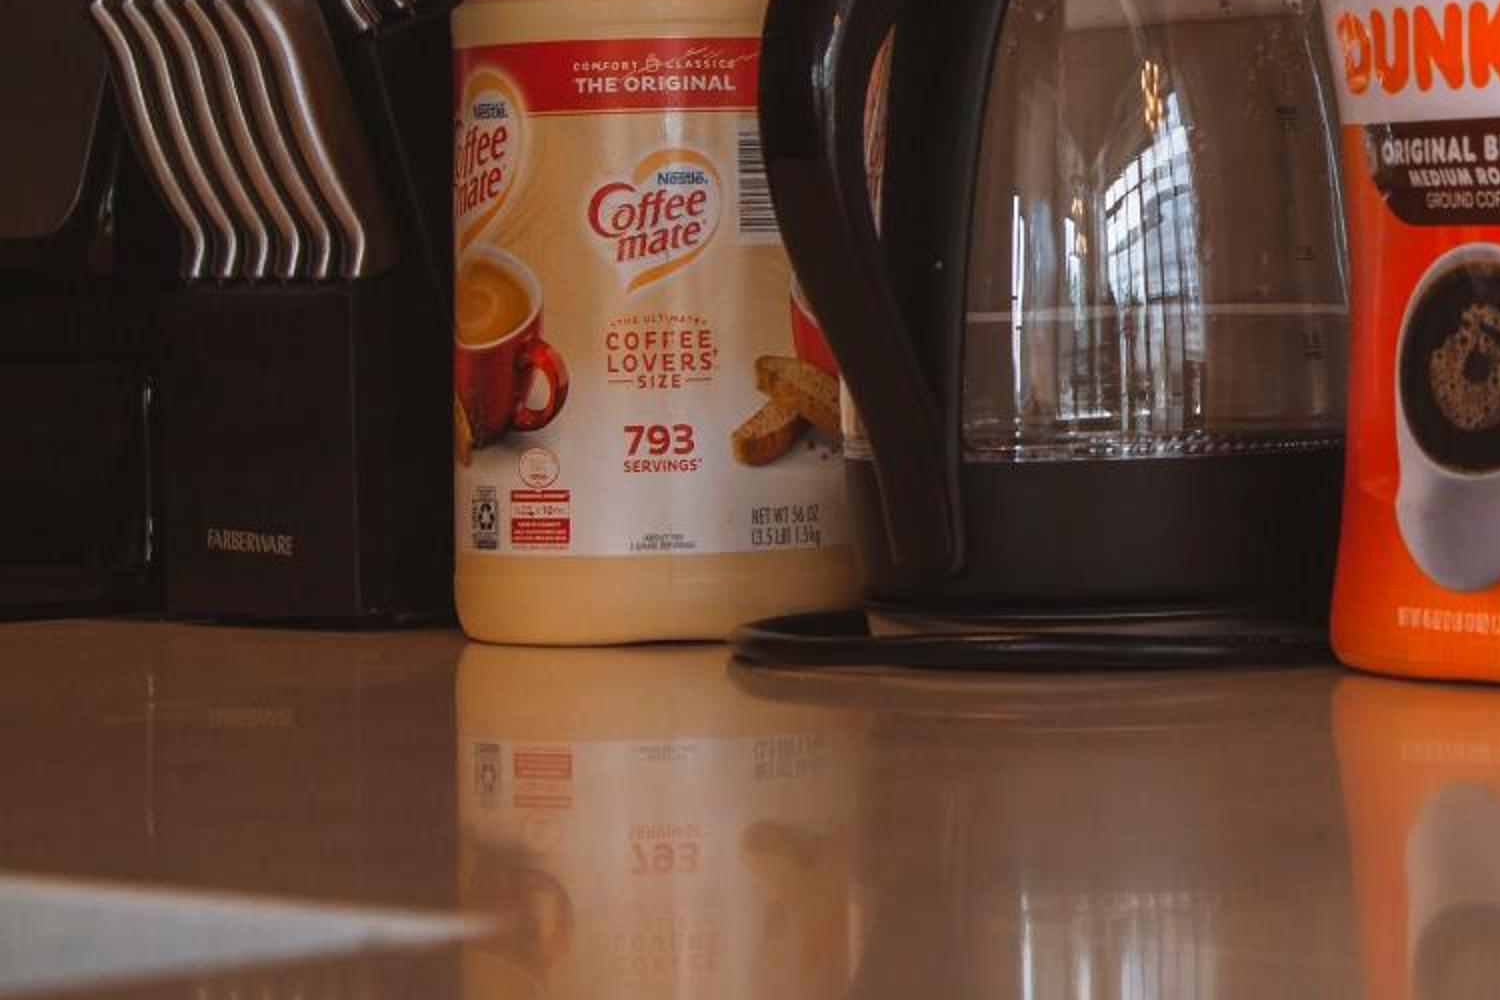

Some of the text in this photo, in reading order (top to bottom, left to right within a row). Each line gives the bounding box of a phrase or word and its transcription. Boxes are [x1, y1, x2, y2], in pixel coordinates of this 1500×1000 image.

[573, 59, 637, 72] COMFORT
[575, 75, 737, 94] THE ORIGINAL
[1381, 134, 1477, 165] ORIGINAL
[1408, 166, 1474, 188] MEDIUM
[587, 181, 707, 239] Coffee
[1425, 191, 1474, 210] GROUND
[617, 221, 702, 263] mate
[606, 330, 712, 351] COFFEE
[637, 374, 682, 389] SIZE
[623, 424, 695, 457] 793
[751, 507, 771, 525] NET
[207, 528, 294, 557] FARBERWARE
